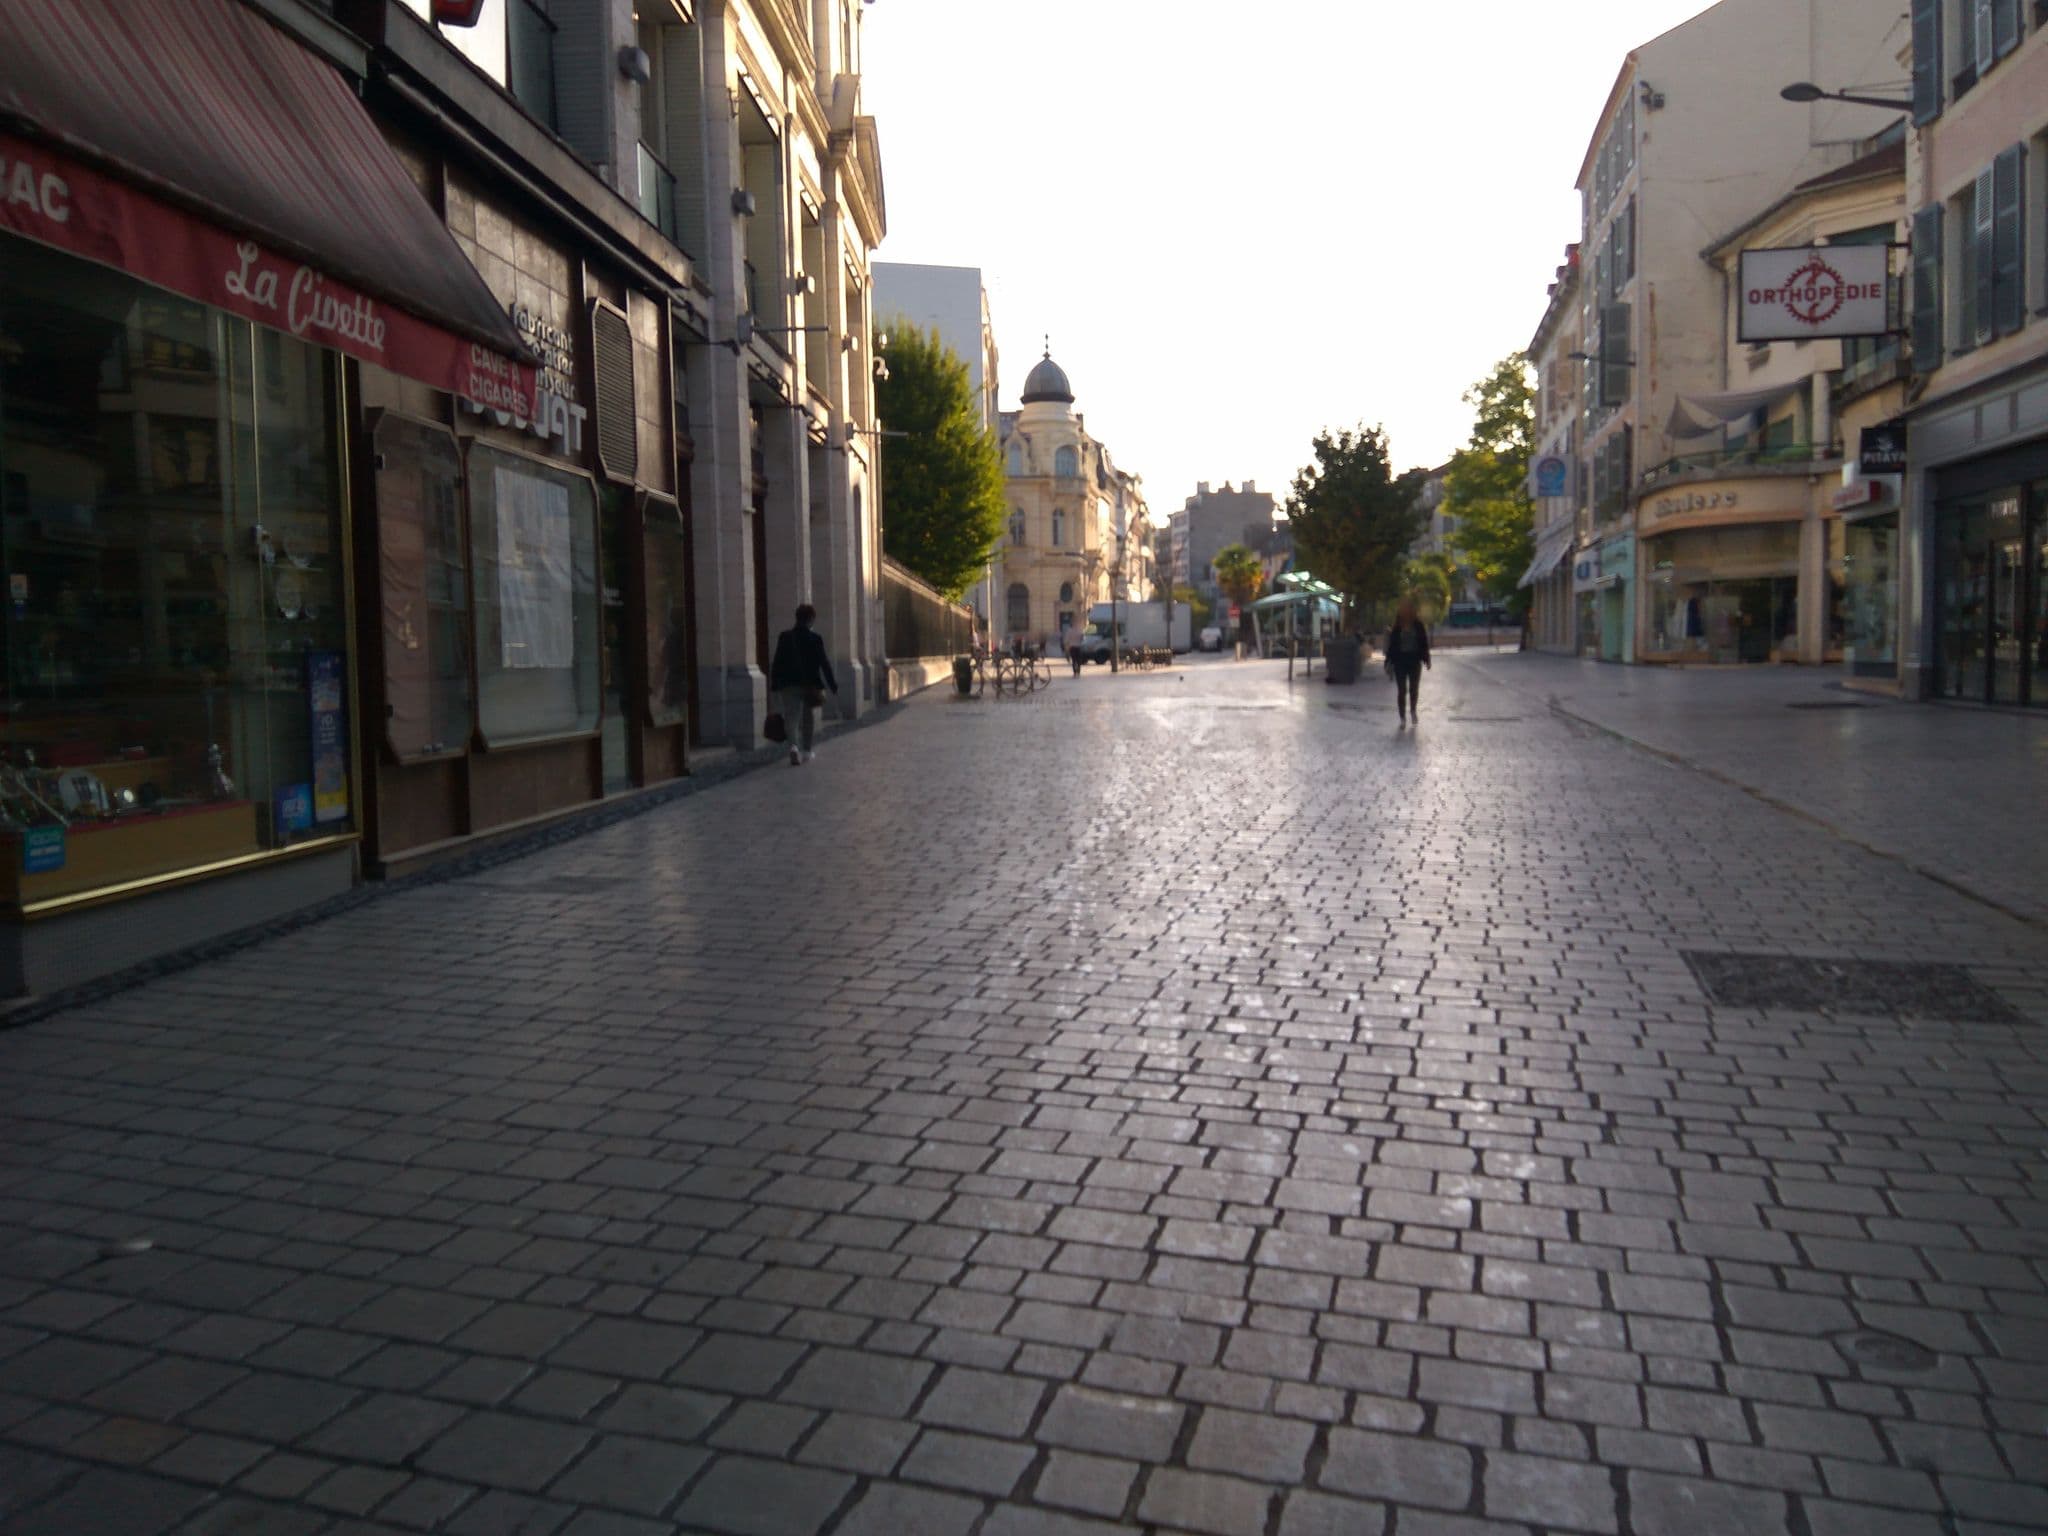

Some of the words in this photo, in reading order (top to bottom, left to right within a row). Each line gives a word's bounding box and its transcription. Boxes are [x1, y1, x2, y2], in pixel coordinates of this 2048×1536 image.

[0, 157, 71, 223] AC
[224, 240, 279, 311] La
[287, 264, 387, 353] Civette
[471, 344, 508, 379] CAVE
